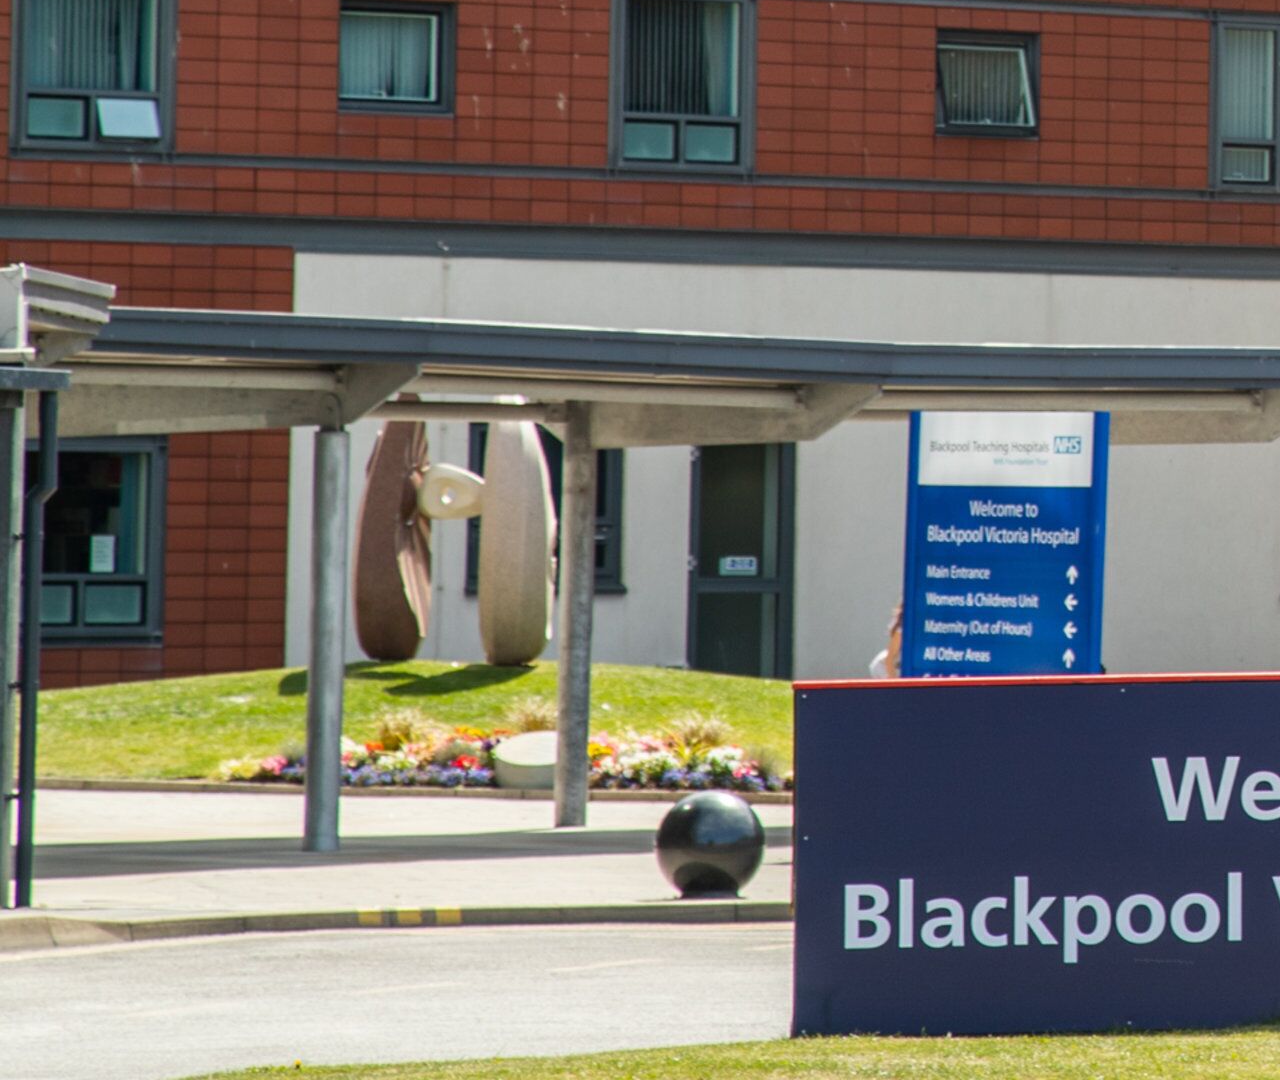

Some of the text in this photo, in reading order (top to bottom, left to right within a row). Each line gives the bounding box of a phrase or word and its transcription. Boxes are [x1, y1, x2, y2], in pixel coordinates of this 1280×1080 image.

[929, 437, 1080, 455] Blackpool Teaching Hospitals NHS
[969, 500, 1039, 518] Welcome to
[927, 525, 1080, 548] Blackpool Victoria Hospital
[926, 565, 991, 580] Main Entrance
[965, 593, 974, 607] &
[1018, 594, 1039, 608] Unit
[924, 619, 1033, 637] Maternity (Out of Hours)
[923, 646, 991, 662] All Other Areas
[843, 871, 1243, 964] Blackpool
